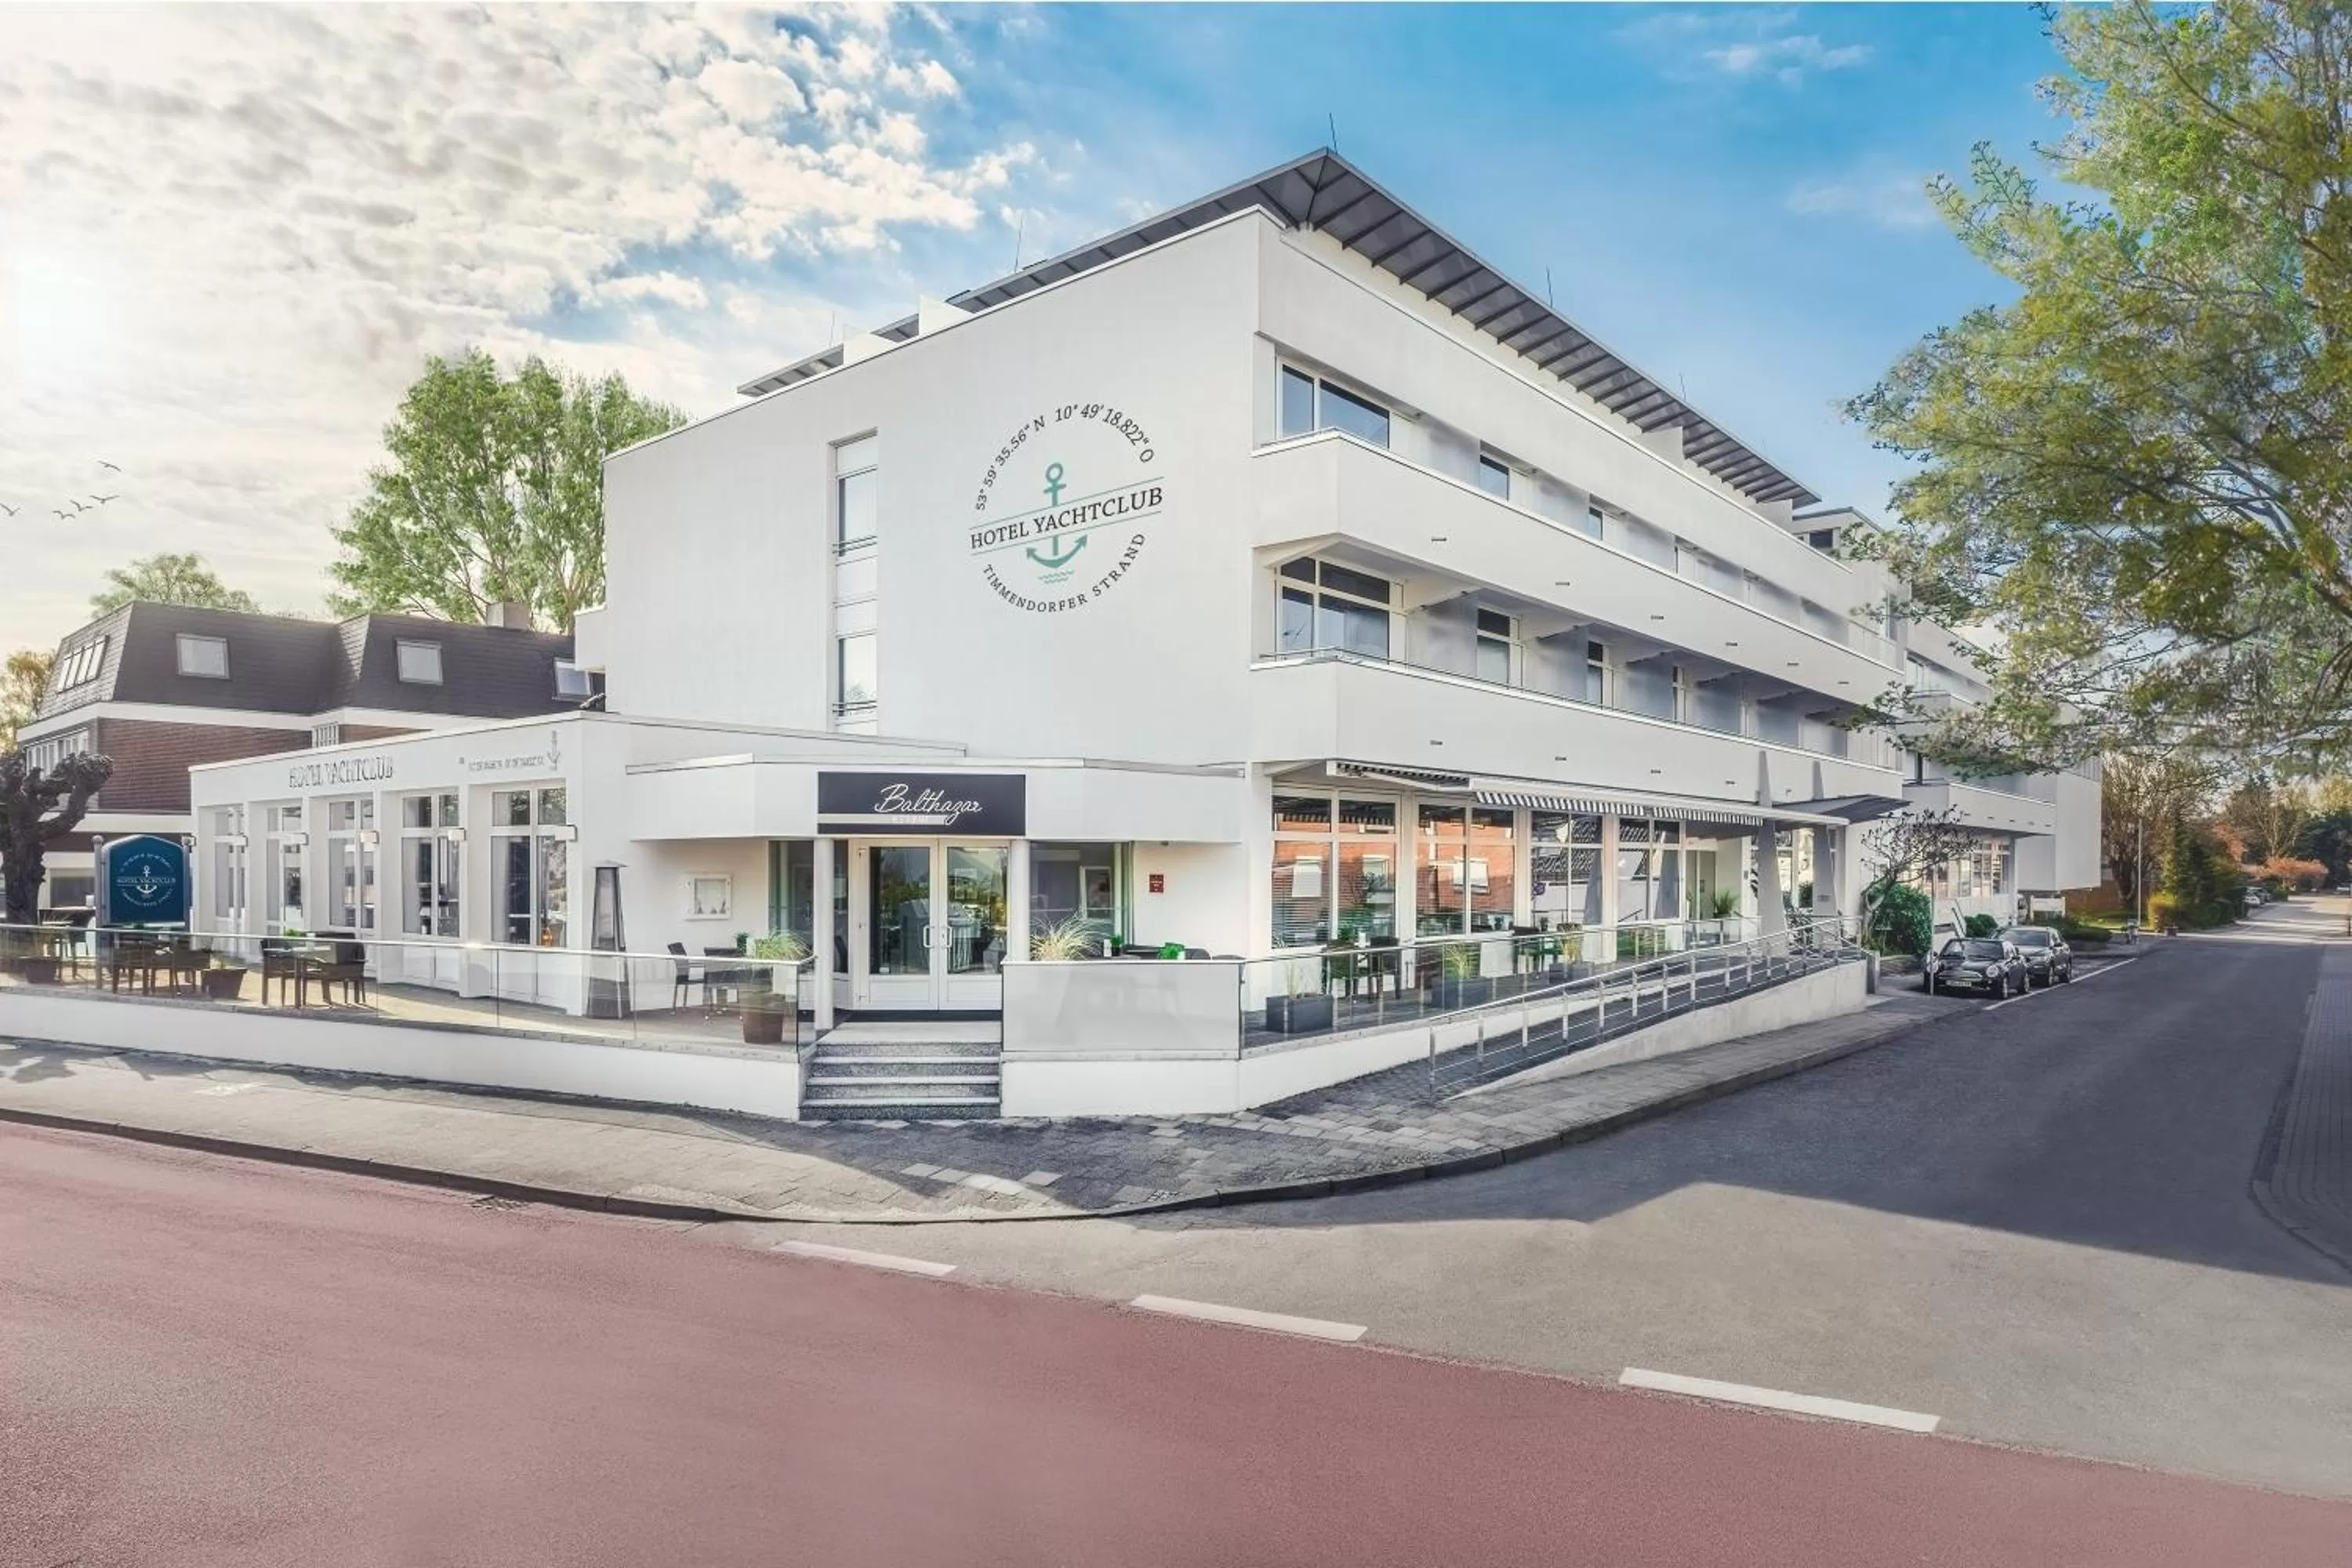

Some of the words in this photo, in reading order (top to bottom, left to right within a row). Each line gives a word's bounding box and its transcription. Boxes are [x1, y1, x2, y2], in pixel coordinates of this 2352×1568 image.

[1034, 415, 1045, 431] N
[1139, 448, 1155, 463] O
[971, 521, 1029, 550] HOTEL
[1033, 486, 1163, 534] YACHTCLUB
[983, 564, 1088, 612] TIMMENDORFER
[1092, 533, 1146, 597] STRAND
[875, 783, 982, 826] Balthazar
